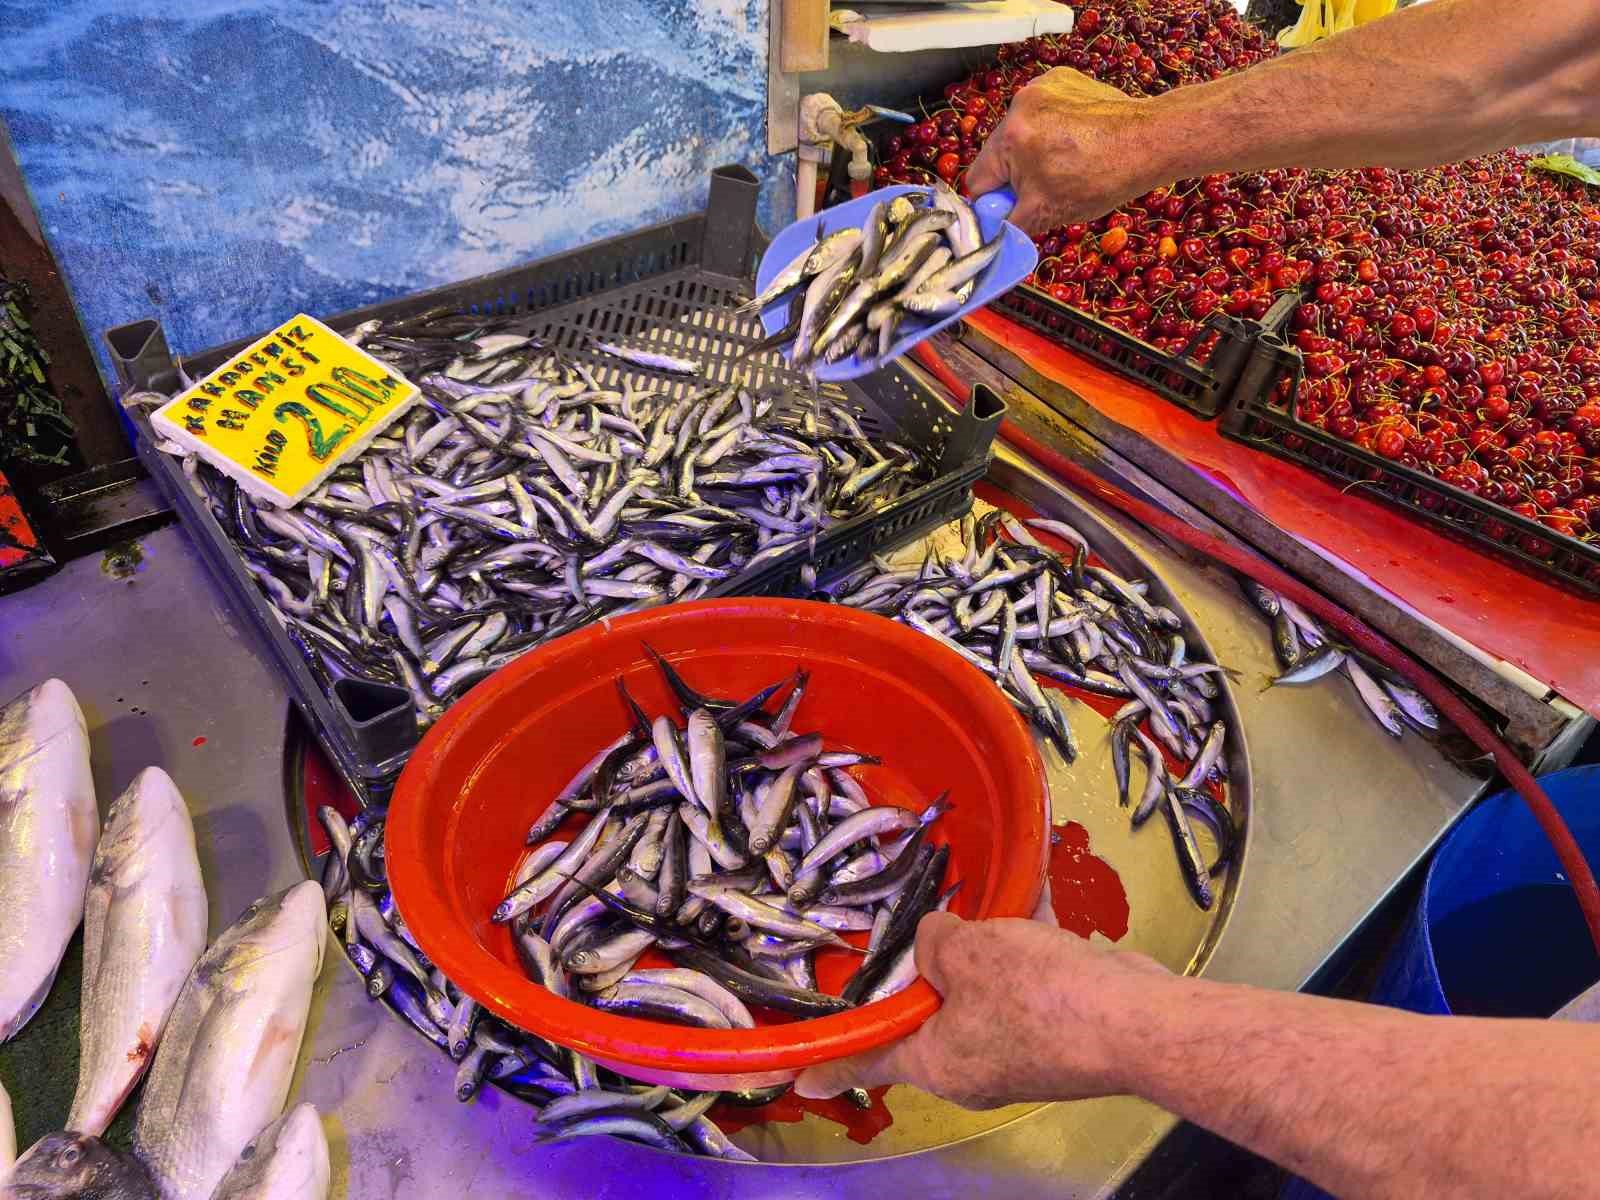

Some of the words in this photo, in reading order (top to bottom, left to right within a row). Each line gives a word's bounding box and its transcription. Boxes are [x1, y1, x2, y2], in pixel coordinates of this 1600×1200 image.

[182, 325, 314, 436] KARADENİZ
[216, 346, 320, 431] HAMSİ
[273, 366, 391, 464] 200
